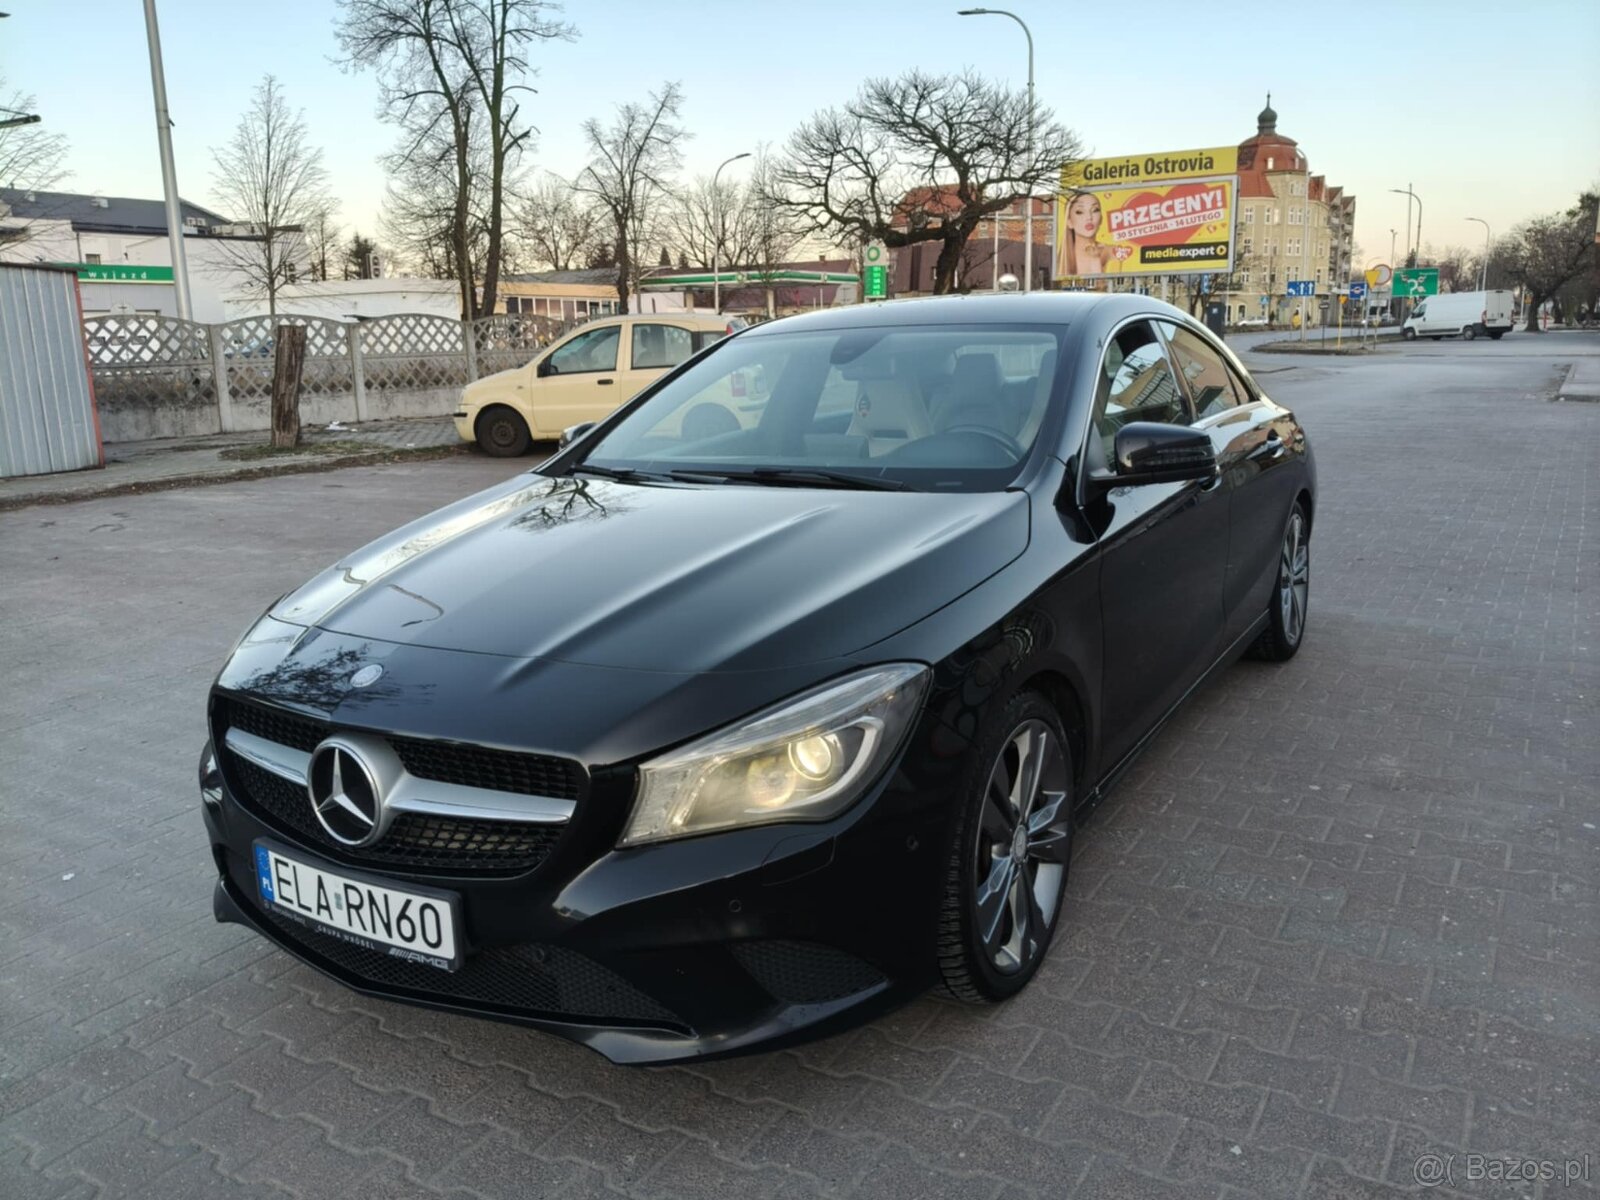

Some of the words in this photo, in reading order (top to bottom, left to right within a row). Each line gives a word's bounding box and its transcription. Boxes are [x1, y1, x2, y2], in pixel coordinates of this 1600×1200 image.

[1083, 159, 1140, 181] Galeria
[1144, 152, 1214, 176] Ostrovia
[1110, 188, 1223, 230] PRZECENY!
[1116, 231, 1126, 240] 30
[1126, 222, 1169, 237] STYCZNIA
[1175, 219, 1184, 227] 14
[1185, 211, 1221, 225] LUTEGO
[1145, 245, 1215, 259] mediaexpert
[88, 270, 148, 280] wyjazd
[262, 876, 273, 892] PL
[274, 857, 334, 921] ELA
[343, 883, 443, 949] RN60
